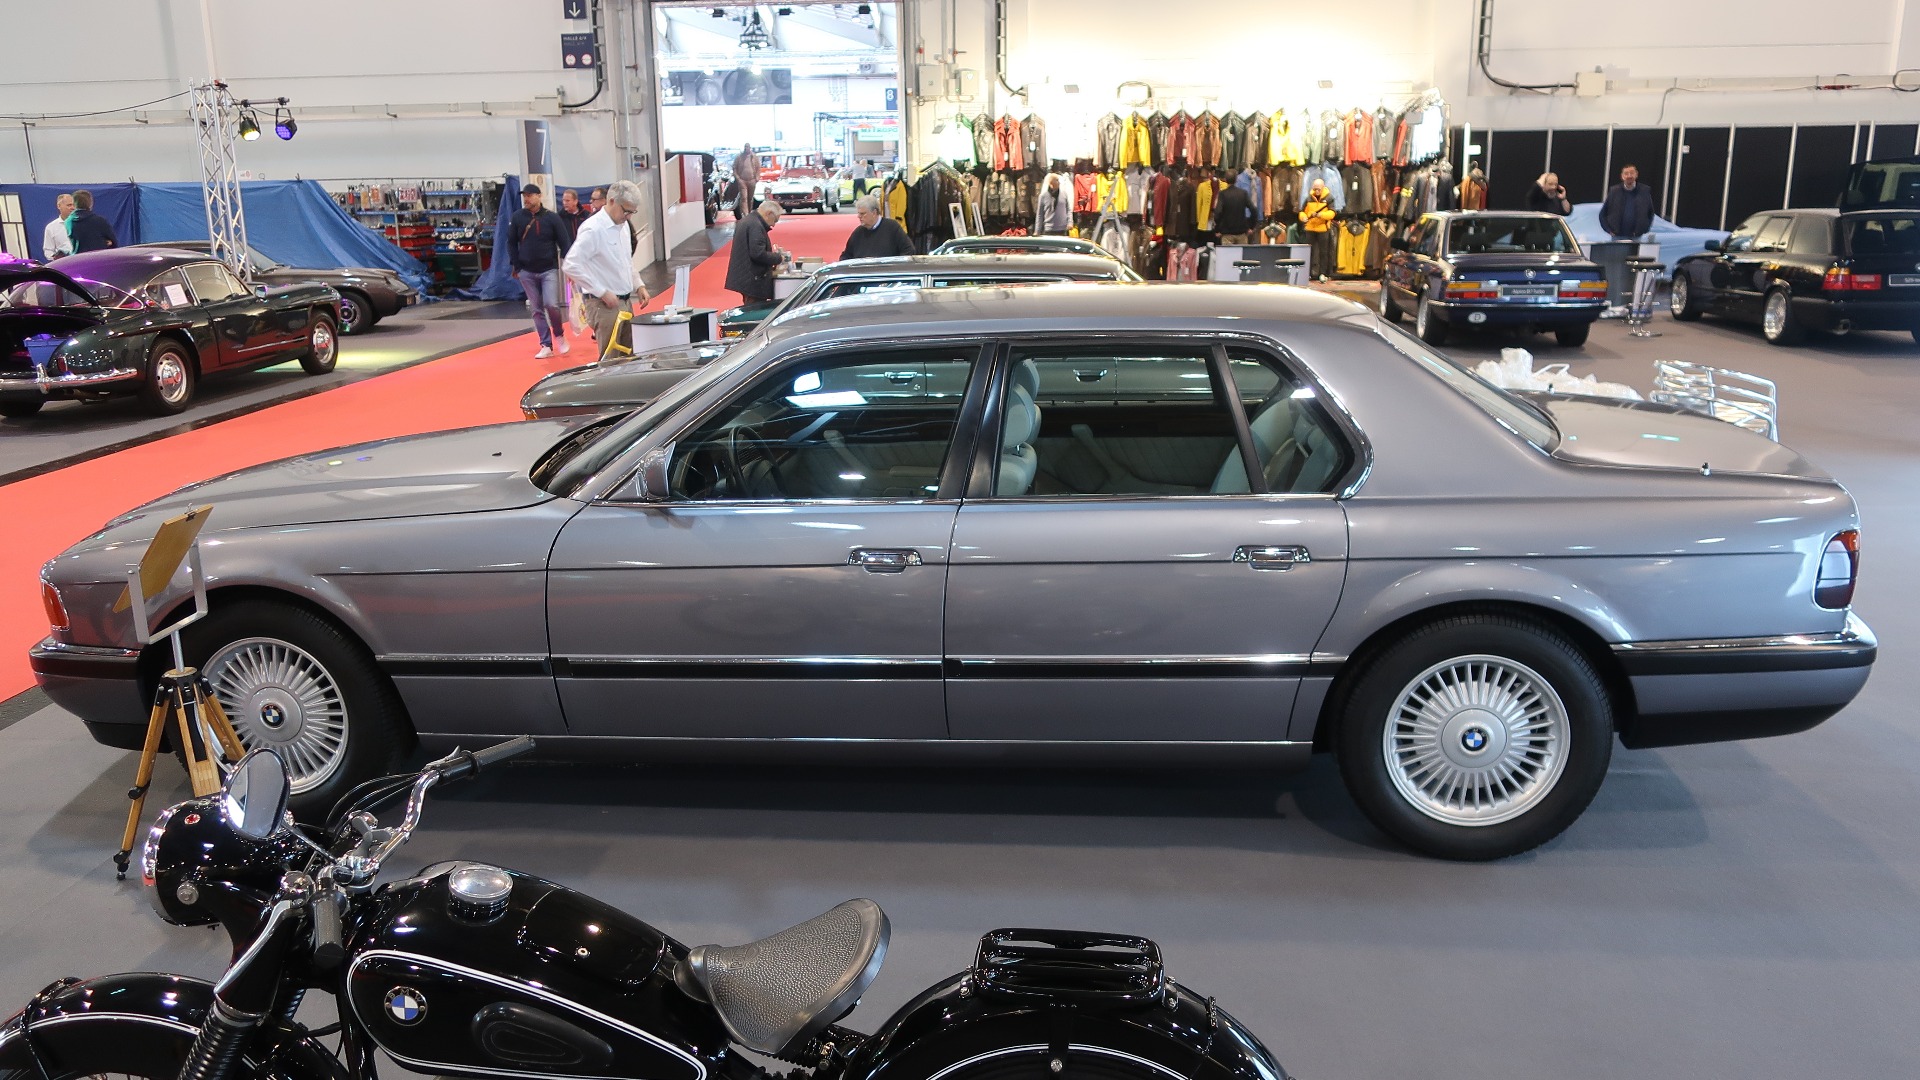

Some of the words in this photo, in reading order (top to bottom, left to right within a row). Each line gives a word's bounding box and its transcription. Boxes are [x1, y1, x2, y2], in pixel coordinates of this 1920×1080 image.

[886, 89, 895, 101] 8
[535, 128, 547, 165] 7
[388, 988, 424, 1002] BMW
